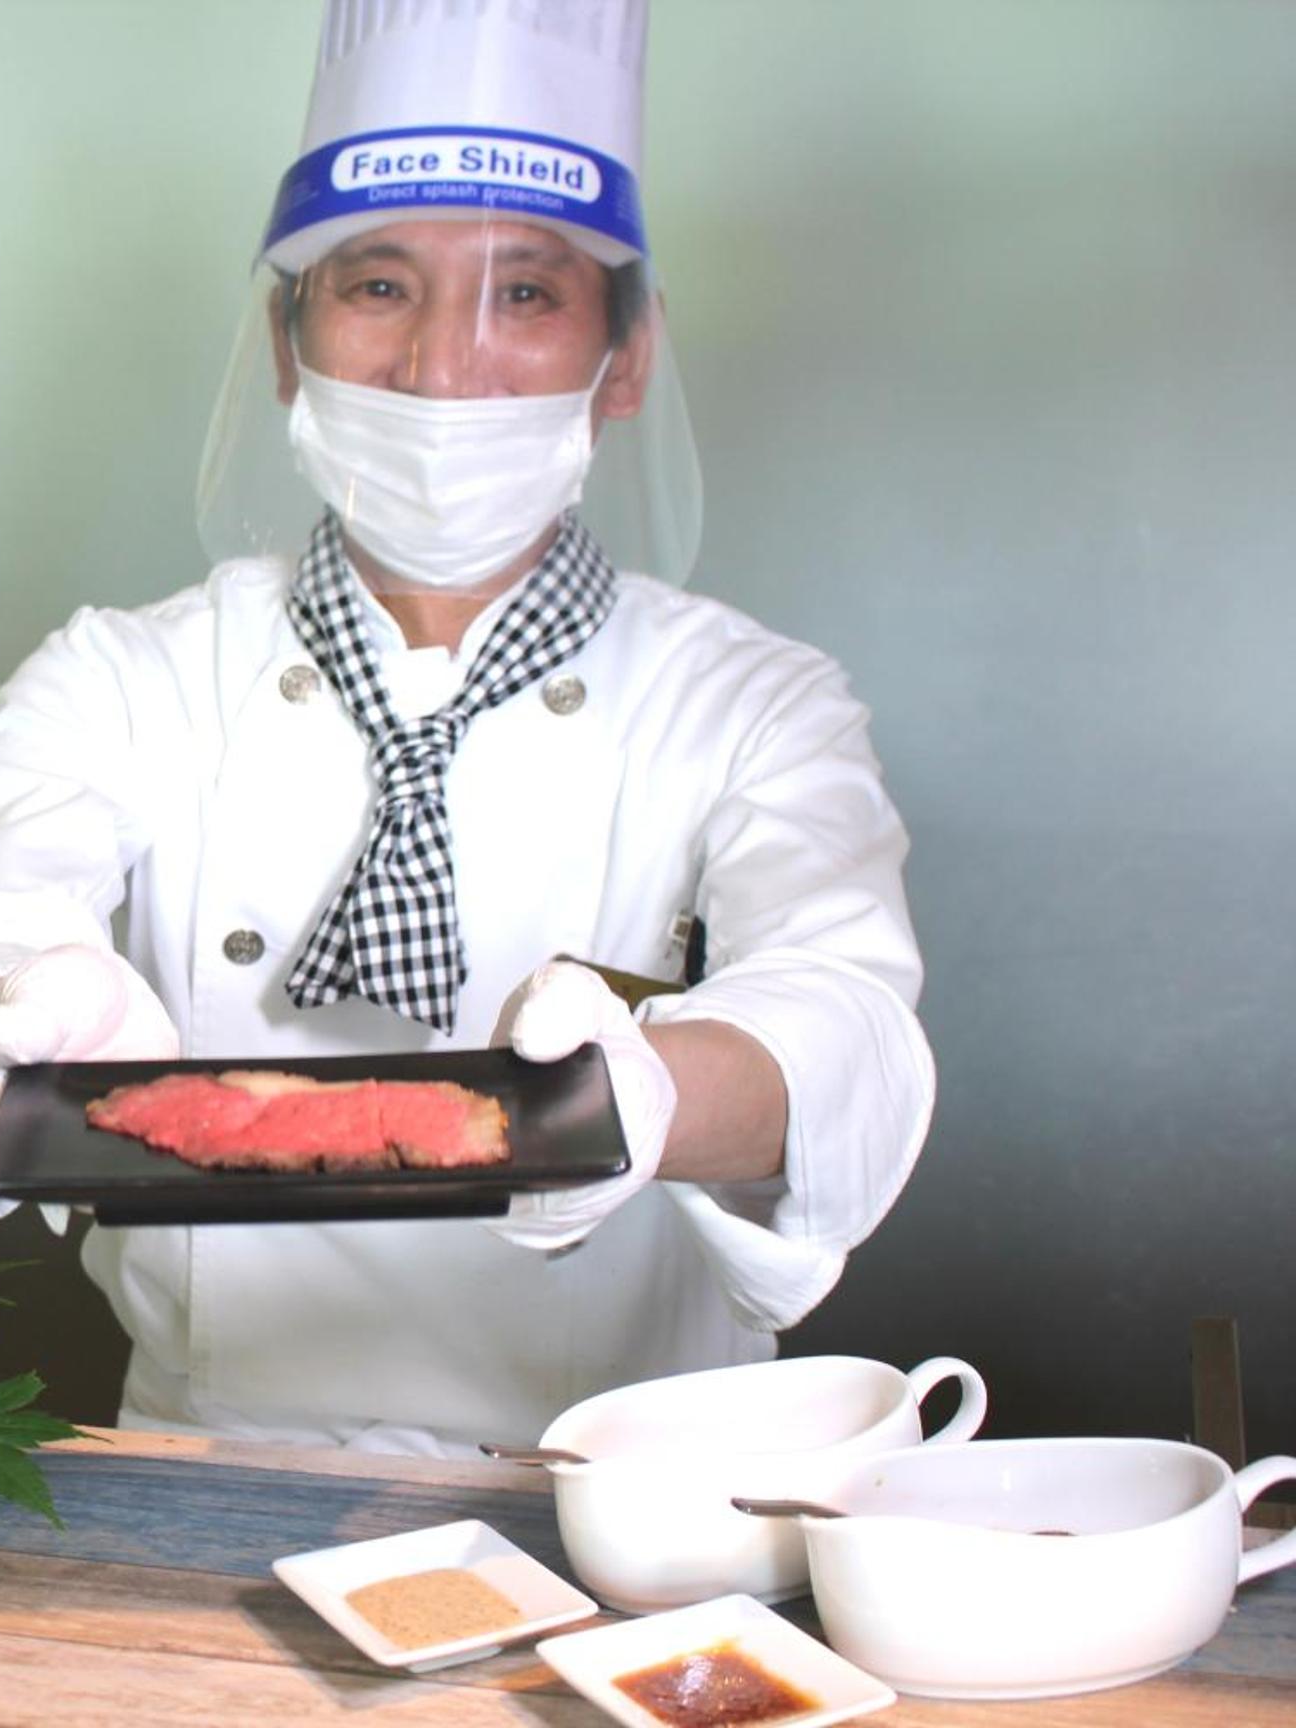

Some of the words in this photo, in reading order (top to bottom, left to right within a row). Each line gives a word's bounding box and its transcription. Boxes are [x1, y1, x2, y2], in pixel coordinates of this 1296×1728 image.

[351, 151, 440, 180] Face
[458, 145, 585, 190] Shield
[369, 184, 417, 202] Direct
[421, 183, 478, 199] splash
[482, 186, 564, 209] protection
